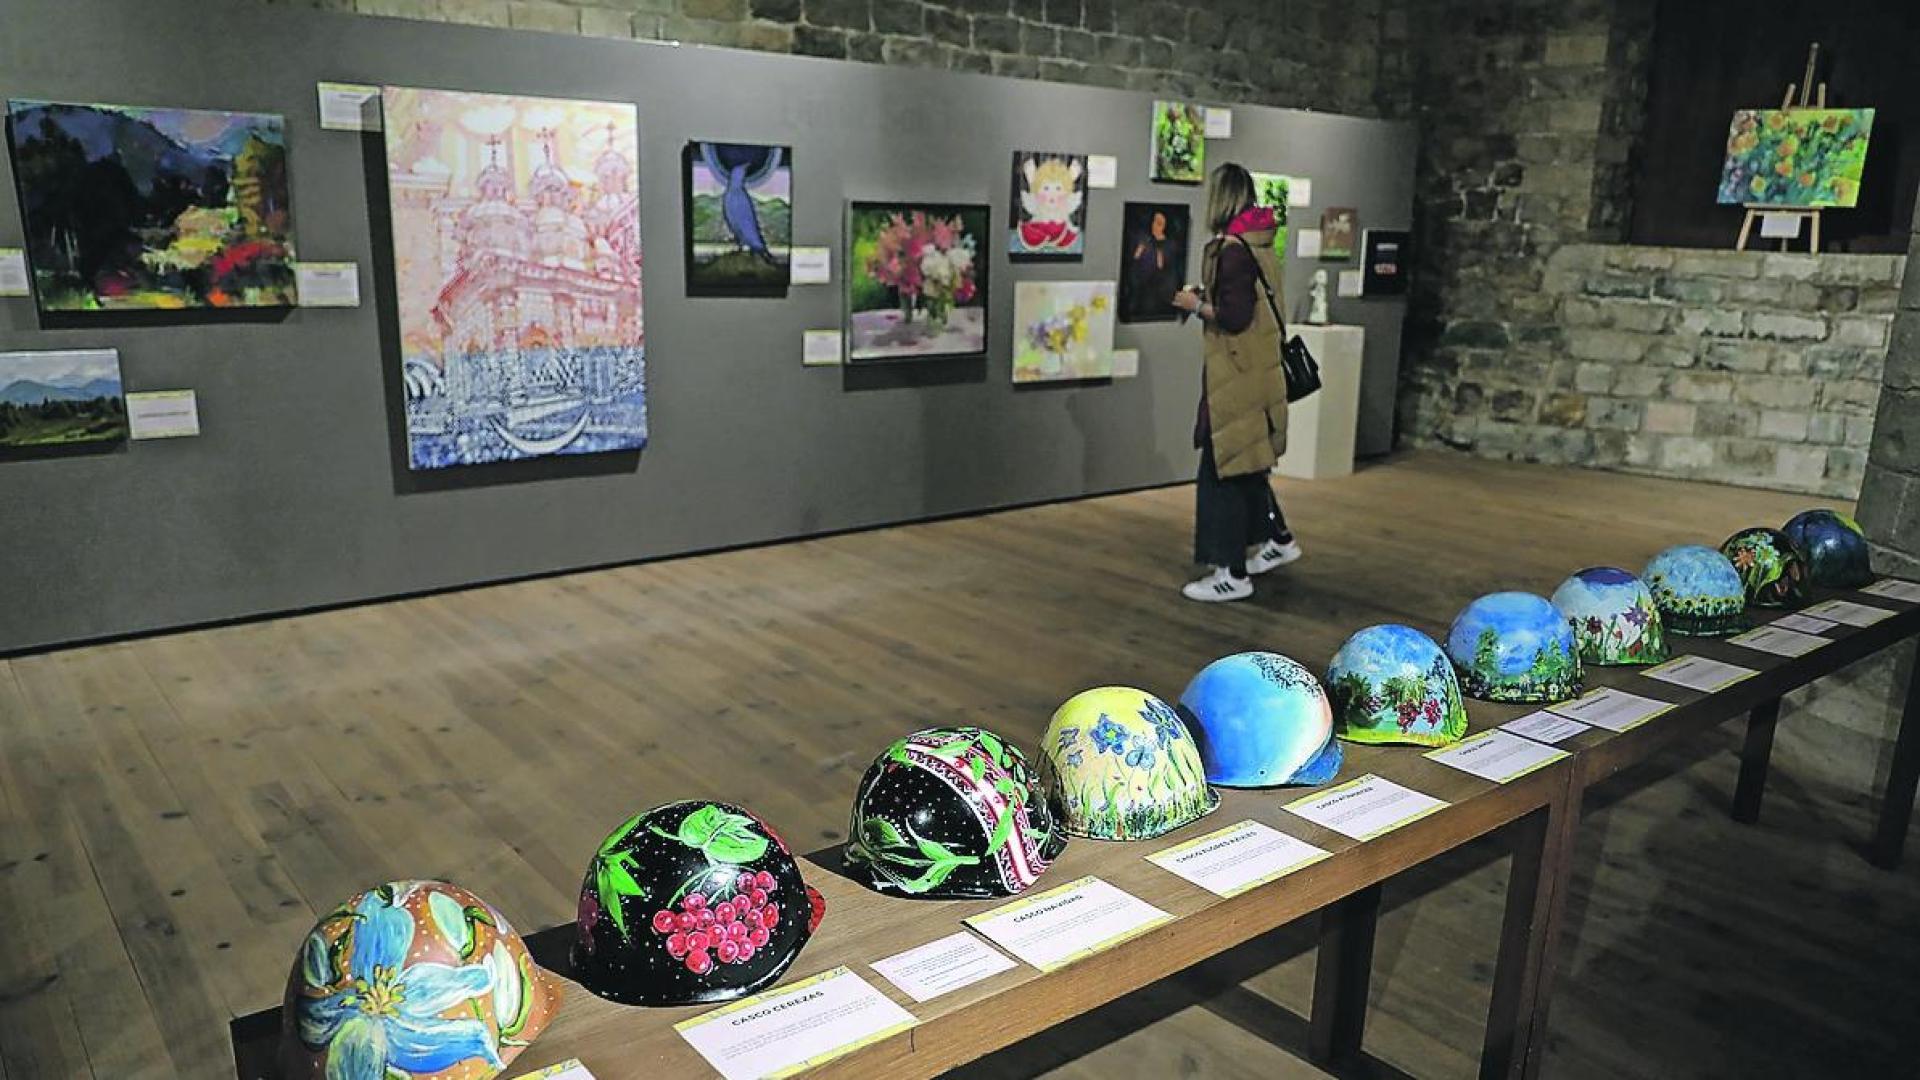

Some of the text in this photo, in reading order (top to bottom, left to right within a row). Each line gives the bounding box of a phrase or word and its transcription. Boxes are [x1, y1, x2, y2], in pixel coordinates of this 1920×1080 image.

[1013, 908, 1044, 924] CASCO
[731, 990, 824, 1026] CASCO CEREZAS
